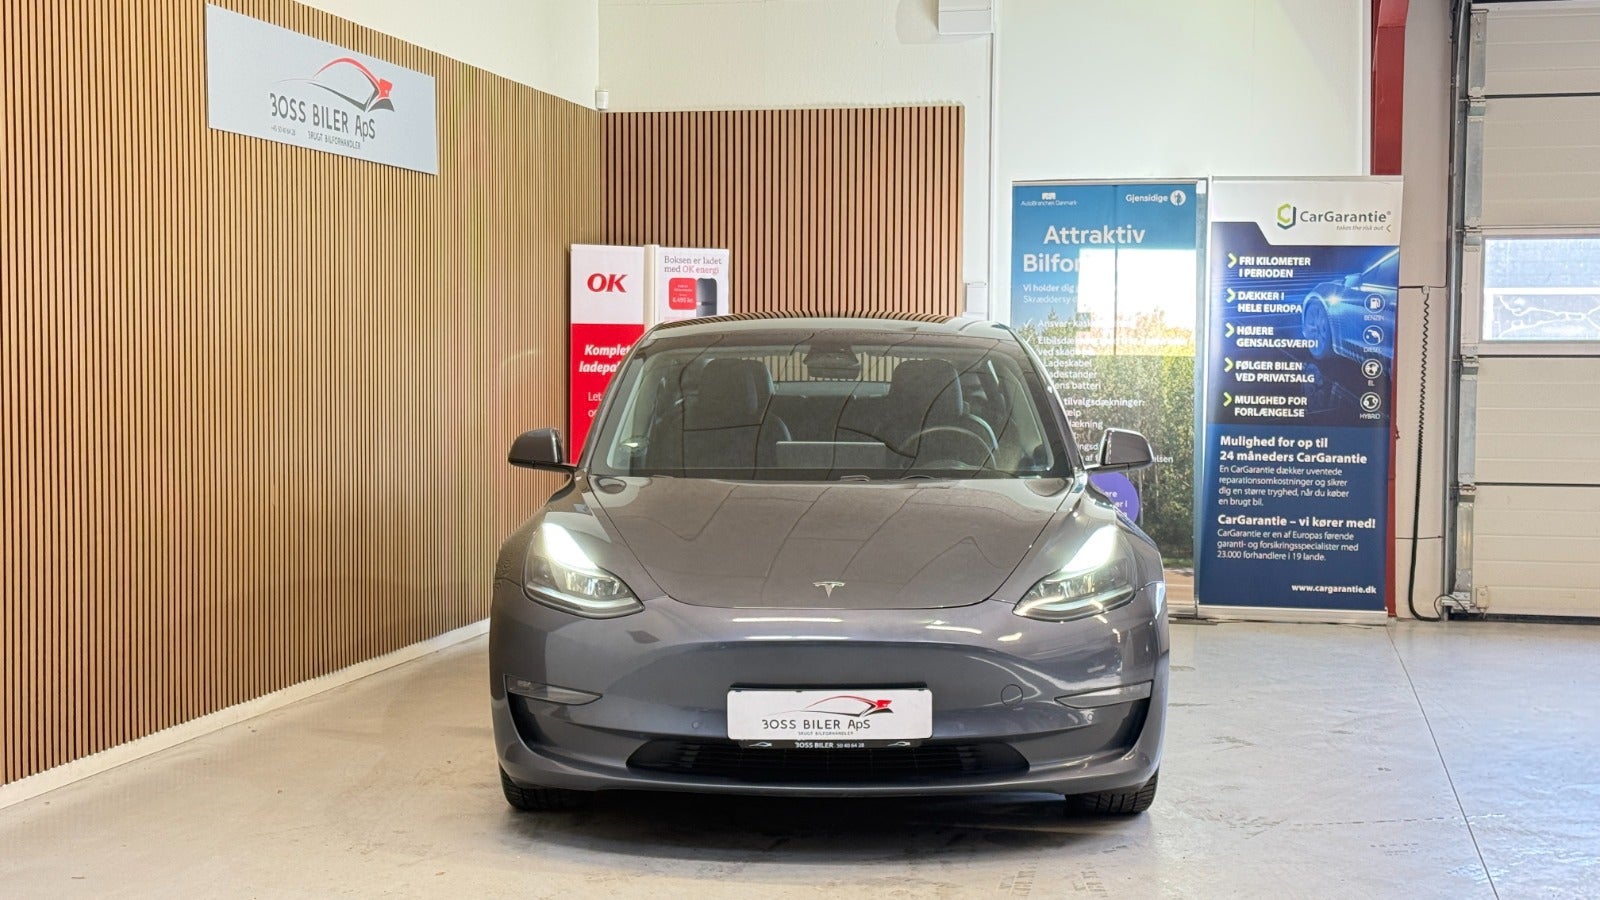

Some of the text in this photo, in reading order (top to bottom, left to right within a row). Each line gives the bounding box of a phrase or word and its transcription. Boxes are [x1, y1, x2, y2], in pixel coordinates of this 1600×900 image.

[313, 103, 349, 133] BILER
[355, 114, 376, 142] ApS
[1126, 194, 1168, 204] Gjensidige
[1044, 225, 1146, 244] Attraktiv
[664, 256, 692, 264] Boksen
[703, 256, 722, 264] ladet
[1239, 256, 1311, 266] FRI KILOMETER
[682, 265, 694, 273] OK
[696, 266, 720, 276] energi
[1244, 269, 1294, 278] PERIODEN
[587, 272, 628, 293] OK
[1033, 284, 1060, 292] holder
[1061, 284, 1074, 294] dig
[1238, 292, 1280, 300] DÆKKER
[1238, 304, 1302, 313] HELE EUROPA
[1236, 326, 1274, 336] HØJERE
[1236, 338, 1318, 349] GENSALGSVÆRDI
[1236, 361, 1302, 371] FØLGER BILEN
[1236, 373, 1315, 383] VED PRIVATSALG
[1235, 396, 1308, 406] MULIGHED FOR
[1234, 408, 1305, 418] FORLÆNGELSE
[1220, 436, 1328, 450] Mulighed for op til
[1220, 450, 1368, 464] 24 måneders CarGarantie
[1230, 466, 1274, 474] CarGarantie
[1276, 466, 1304, 474] dækker
[1306, 468, 1342, 476] uventede
[1219, 476, 1348, 488] reparationsomkostninger og sikrer
[1218, 486, 1232, 496] dig
[1244, 488, 1266, 496] større
[1268, 488, 1300, 498] tryghed,
[1300, 488, 1314, 496] når
[1326, 489, 1350, 498] køber
[1230, 498, 1252, 508] brugt
[1252, 498, 1264, 506] bil.
[1218, 514, 1287, 526] CarGarantie
[1299, 517, 1310, 526] vi
[1312, 518, 1344, 528] kører
[1346, 518, 1376, 529] med!
[1218, 528, 1262, 538] CarGarantie
[1284, 530, 1292, 538] af
[1292, 530, 1322, 540] Europas
[1324, 532, 1354, 540] førende
[1217, 540, 1359, 552] garanti- og forsikringsspecialister med
[1216, 550, 1242, 558] 23.000
[1243, 550, 1286, 560] forhandlere
[1292, 552, 1302, 560] 19
[1302, 552, 1326, 561] lande.
[1291, 584, 1377, 594] www.cargarantie.dk
[803, 719, 841, 730] BILER
[848, 719, 871, 732] ApS
